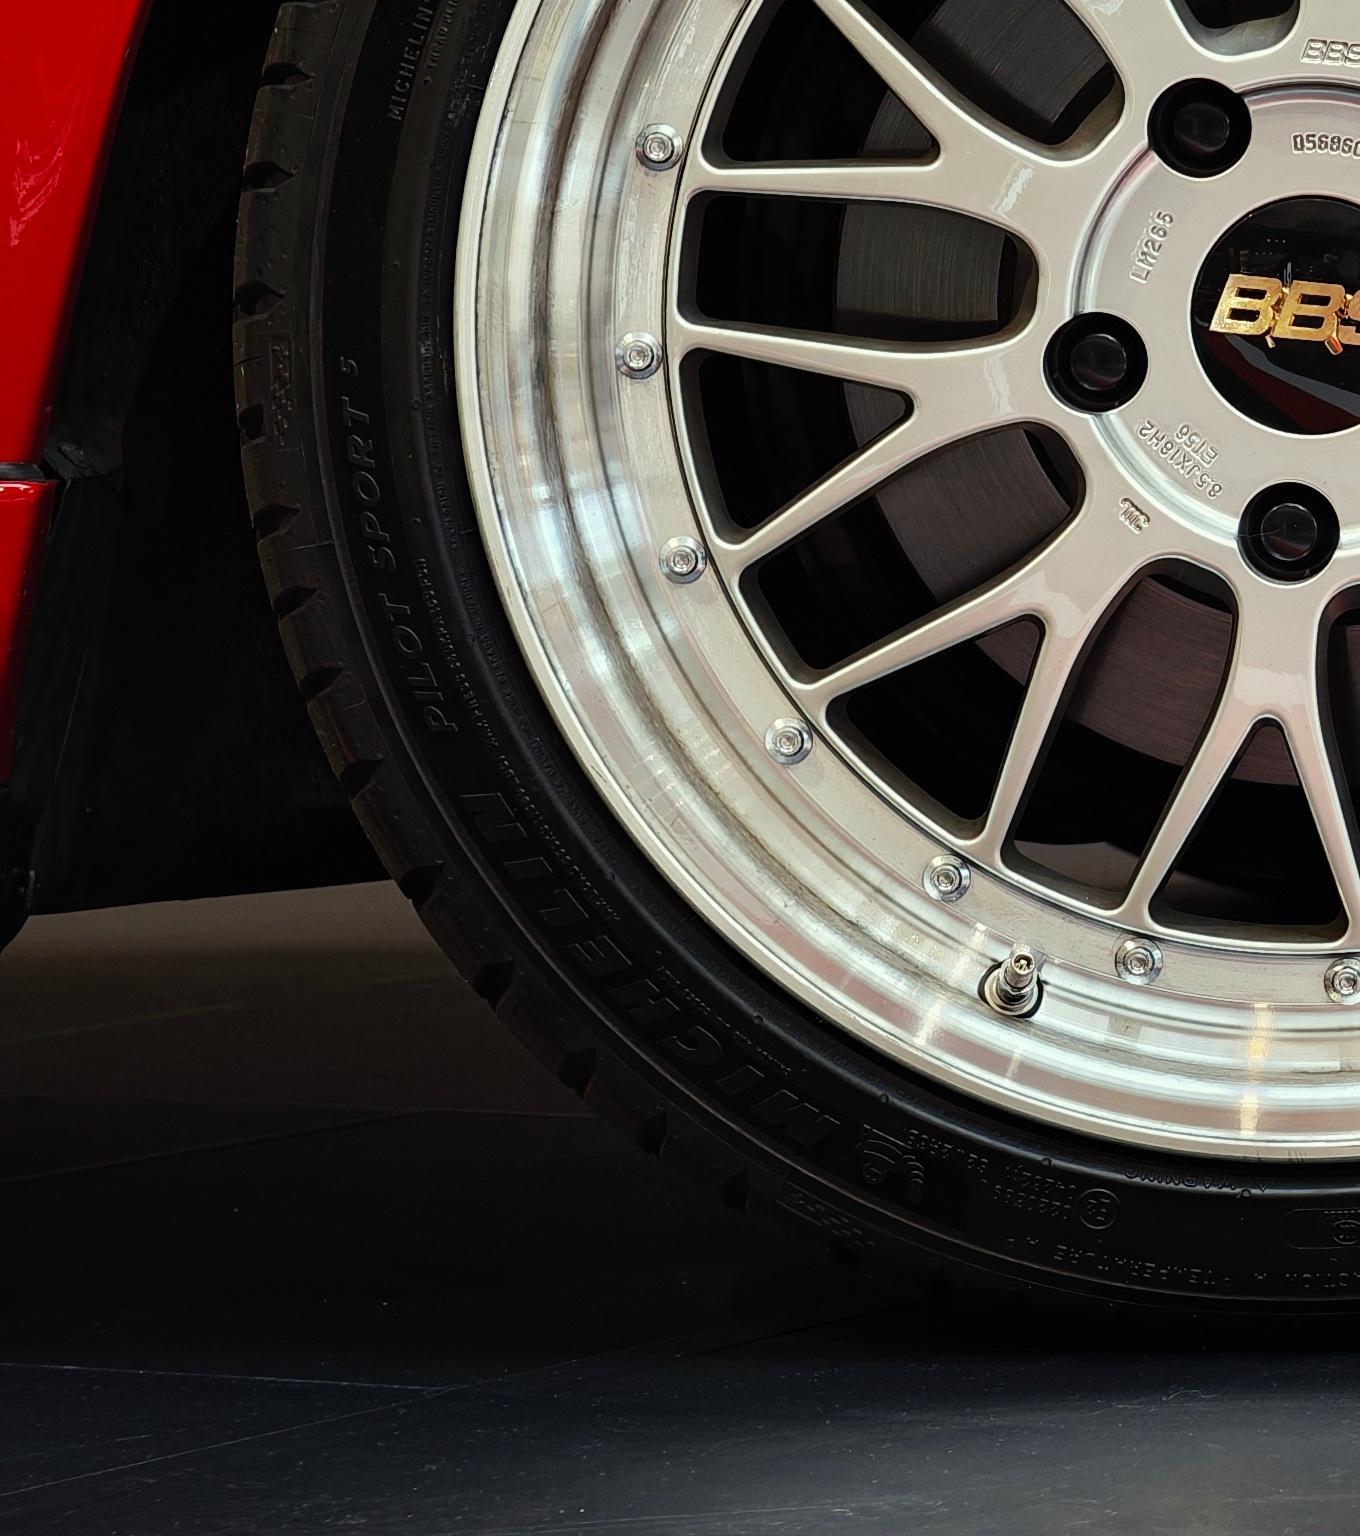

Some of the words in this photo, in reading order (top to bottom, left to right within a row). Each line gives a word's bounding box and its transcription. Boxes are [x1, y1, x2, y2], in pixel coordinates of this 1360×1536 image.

[337, 353, 359, 378] 5
[340, 392, 399, 580] SPORT
[376, 583, 460, 743] PILOT
[459, 784, 839, 1150] MICHELIN
[1122, 1163, 1237, 1193] WARNING
[1052, 1242, 1216, 1288] TEMPERATURE
